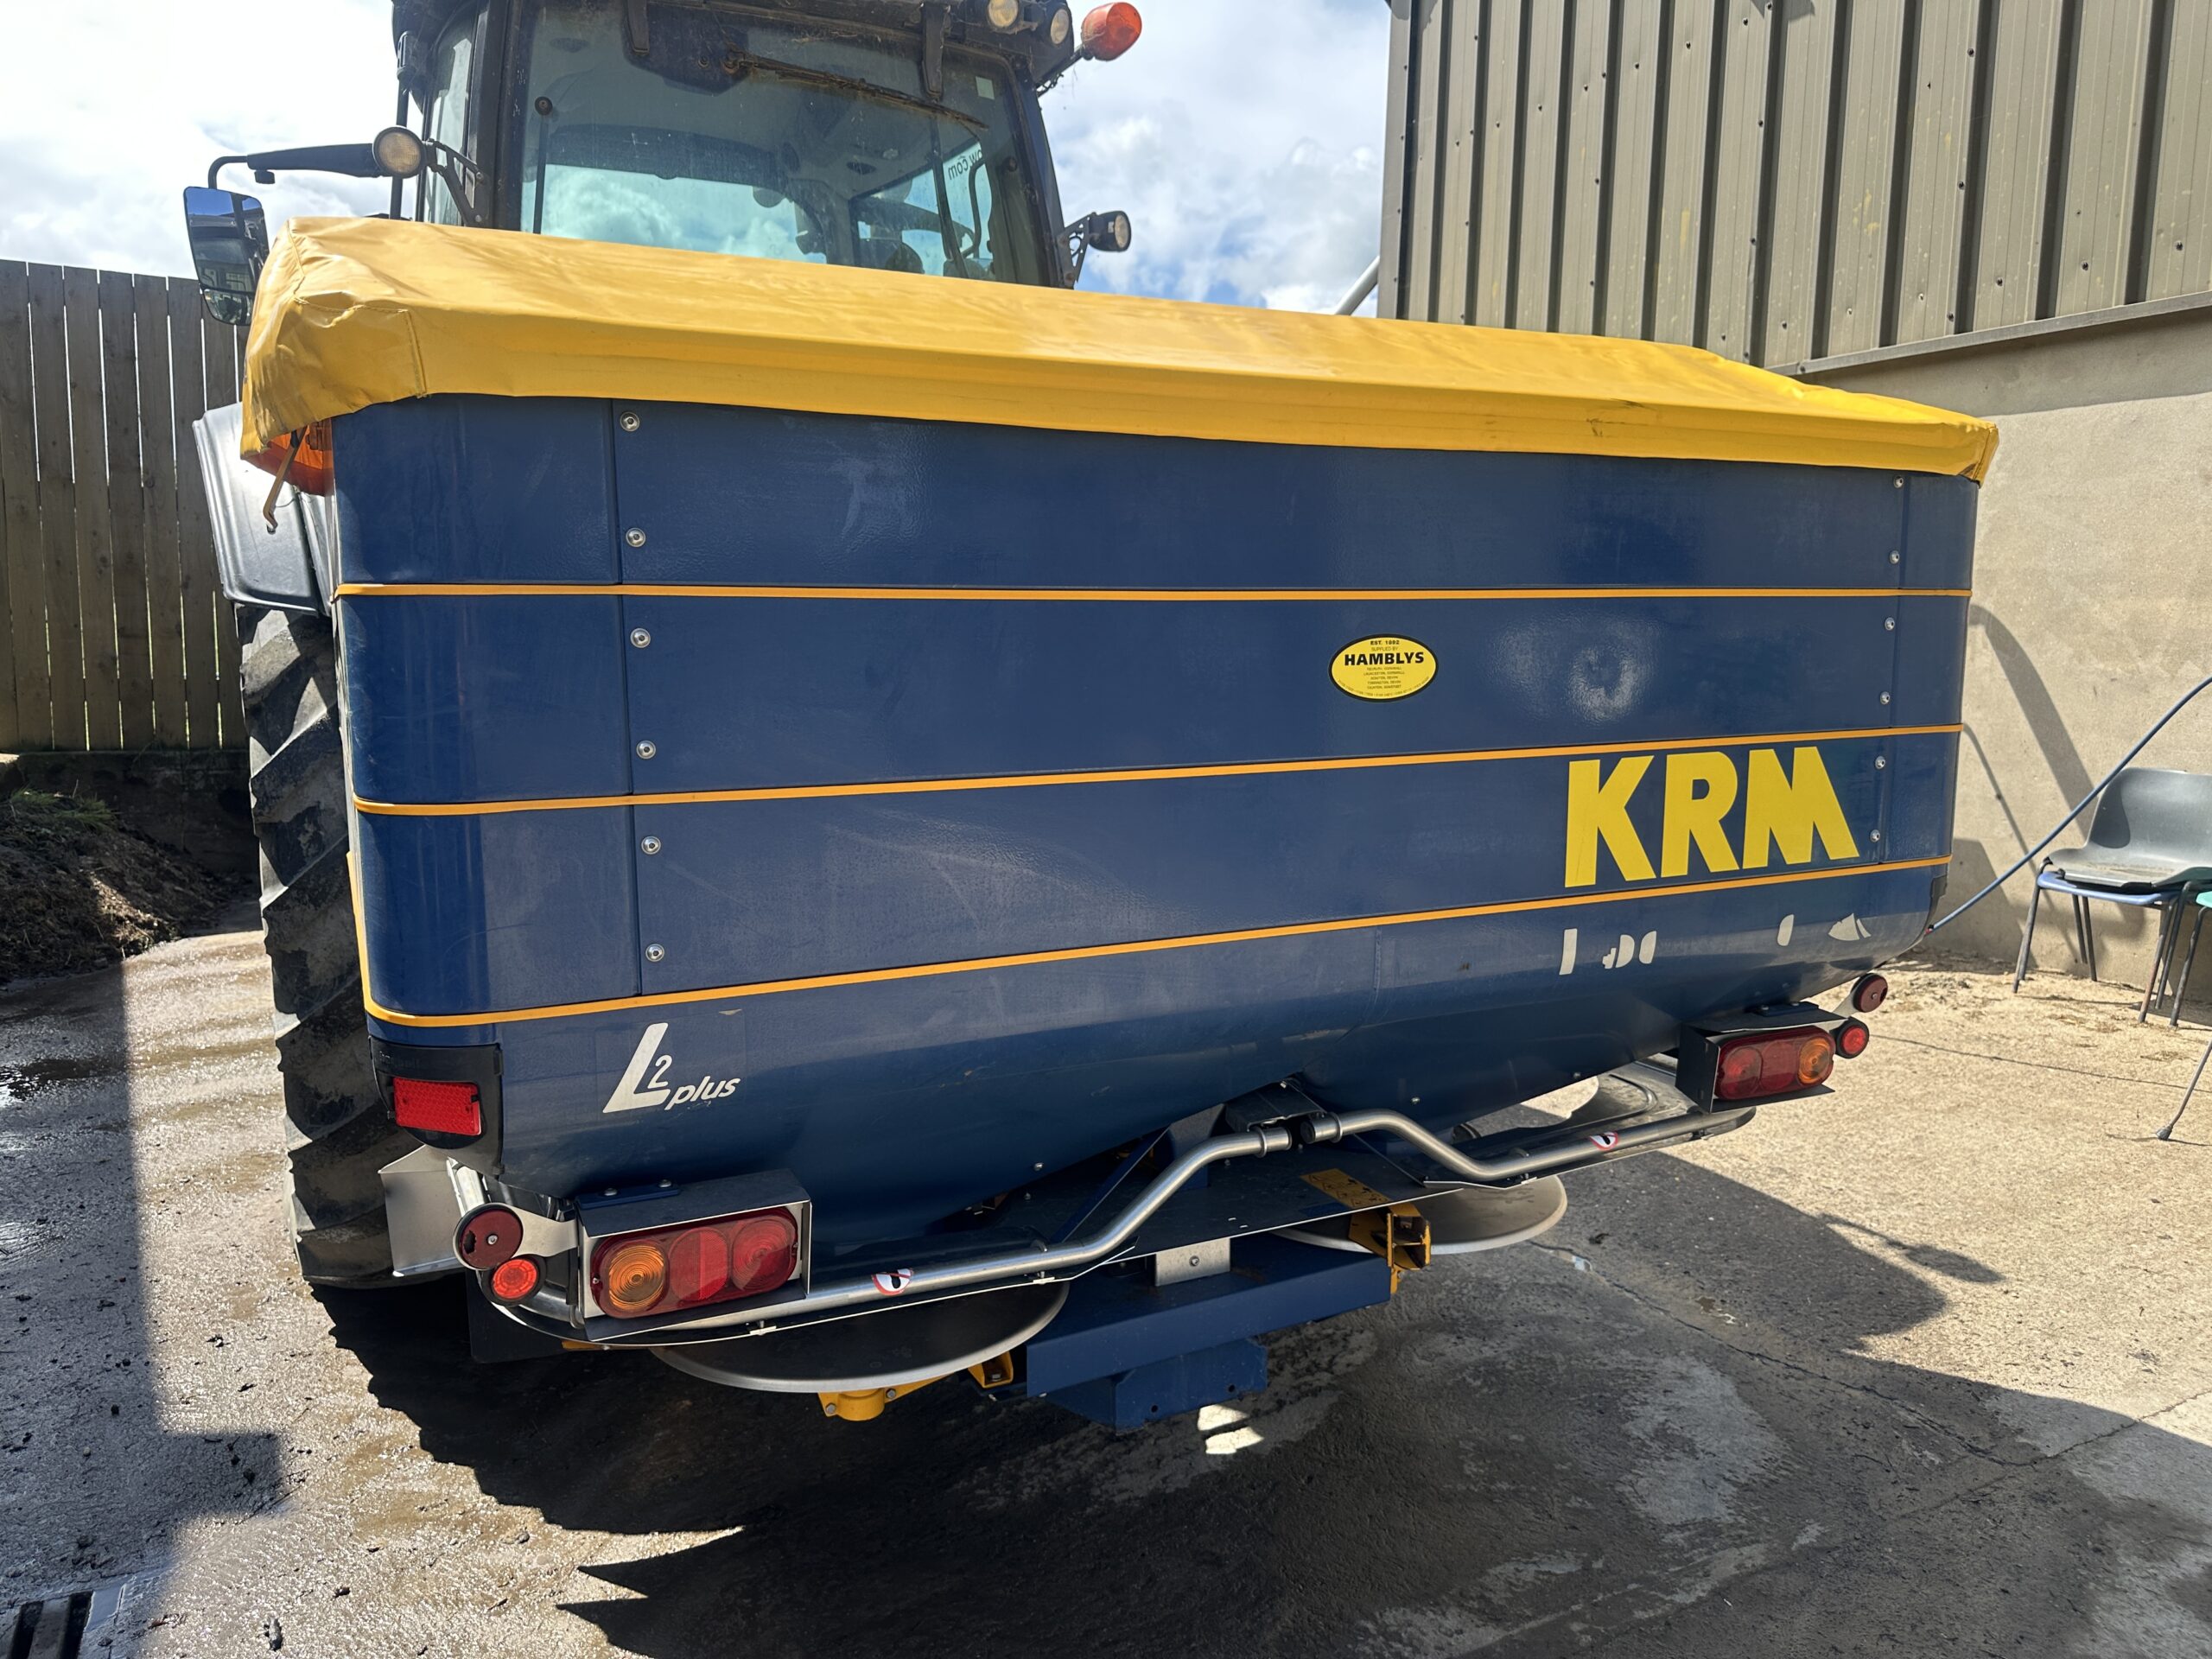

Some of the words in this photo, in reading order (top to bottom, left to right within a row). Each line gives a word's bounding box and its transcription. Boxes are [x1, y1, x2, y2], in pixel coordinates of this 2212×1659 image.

[1344, 652, 1424, 666] HAMBLYS
[1565, 747, 1859, 887] KRM
[664, 1076, 741, 1110] plus
